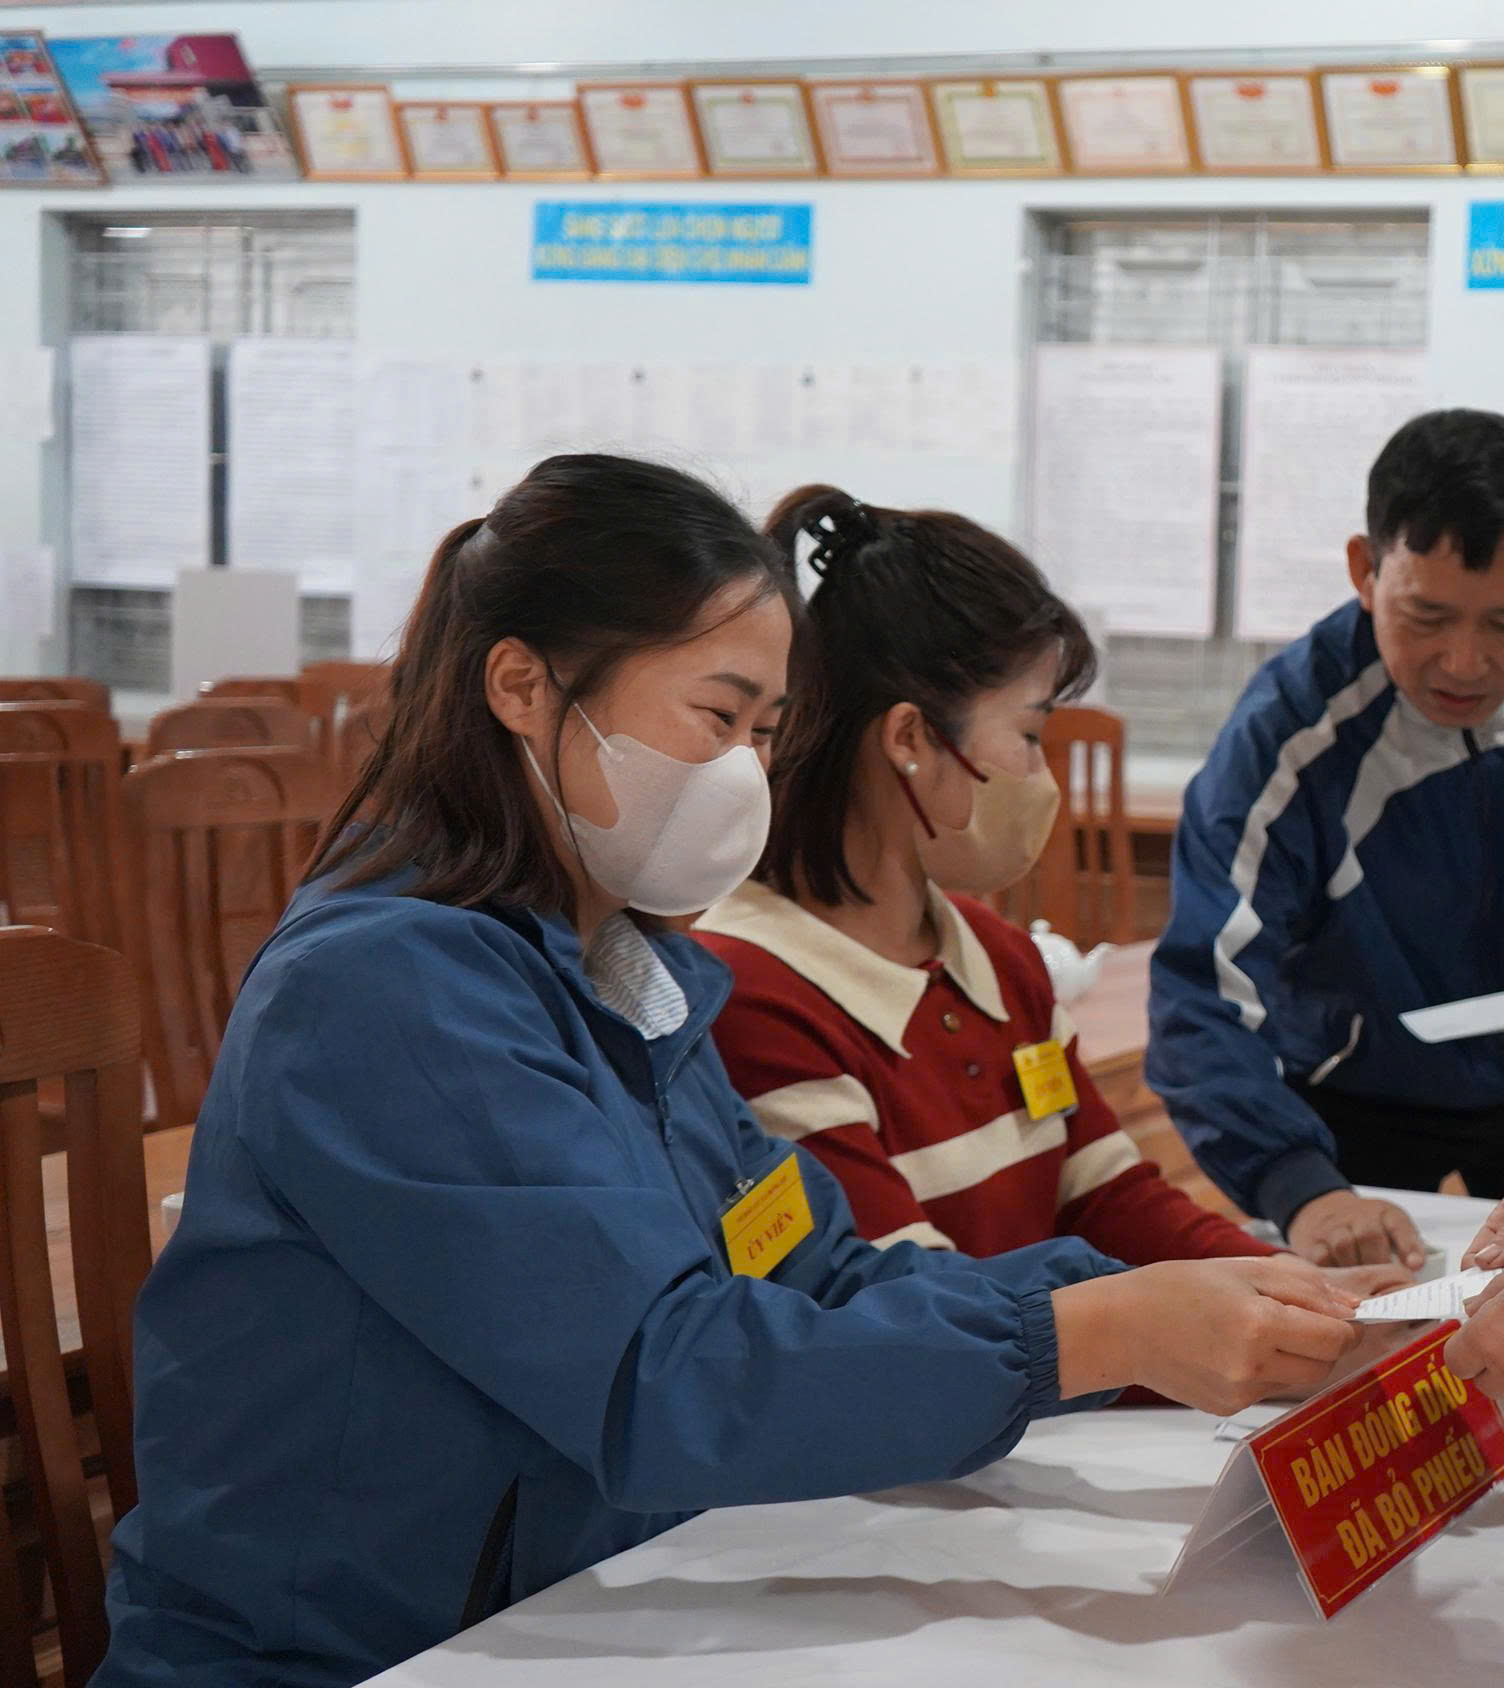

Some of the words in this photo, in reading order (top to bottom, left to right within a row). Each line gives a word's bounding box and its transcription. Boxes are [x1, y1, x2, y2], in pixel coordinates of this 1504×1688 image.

[1290, 1433, 1356, 1508] BÀN
[1347, 1392, 1423, 1470] ĐÓNG
[1414, 1354, 1468, 1425] DẤU
[1336, 1498, 1386, 1569] ĐÃ
[1375, 1467, 1422, 1542] BỎ
[1411, 1426, 1486, 1515] PHIẾU
